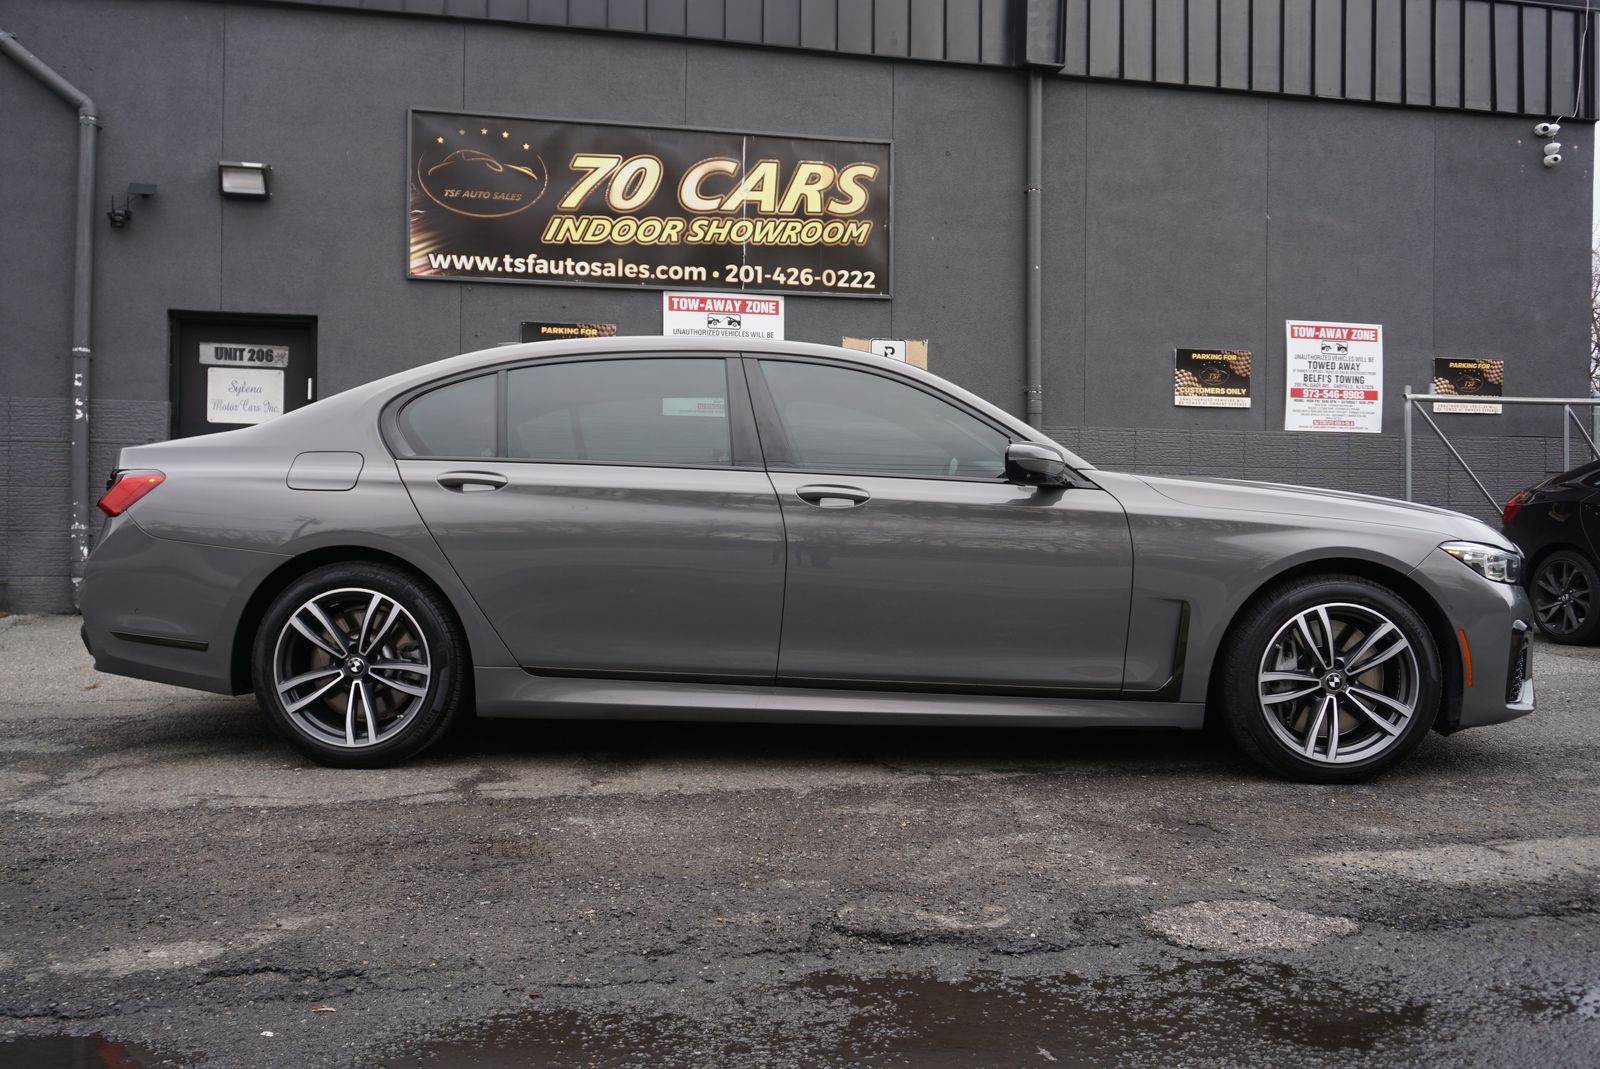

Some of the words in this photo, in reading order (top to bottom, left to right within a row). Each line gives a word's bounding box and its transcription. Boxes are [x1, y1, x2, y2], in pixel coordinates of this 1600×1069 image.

[558, 153, 663, 213] 70
[678, 157, 879, 216] CARS
[444, 189, 461, 197] TSF
[462, 190, 490, 199] AUTO
[493, 192, 522, 201] SALES
[541, 215, 684, 245] INDOOR
[685, 218, 872, 246] SHOWROOM
[428, 253, 706, 281] www.tsfautosales.com
[725, 264, 875, 289] 201-426-0222
[672, 297, 741, 313] TOW-AWAY
[745, 300, 776, 314] ZONE
[541, 326, 579, 335] PARKING
[580, 328, 598, 336] FOR
[673, 329, 720, 337] UNAUTHORIZED
[720, 330, 749, 338] VEHICLES
[1292, 326, 1349, 339] TOW-AWAY
[1351, 328, 1376, 340] ZONE
[214, 347, 245, 362] UNIT
[247, 349, 274, 362] 206
[1308, 361, 1336, 370] TOWED
[1338, 362, 1361, 371] AWAY
[1303, 374, 1332, 384] BELFI'S
[1335, 375, 1365, 385] TOWING
[1180, 387, 1226, 395] CUSTOMERS
[211, 399, 238, 412] Motor
[239, 399, 260, 412] Cars
